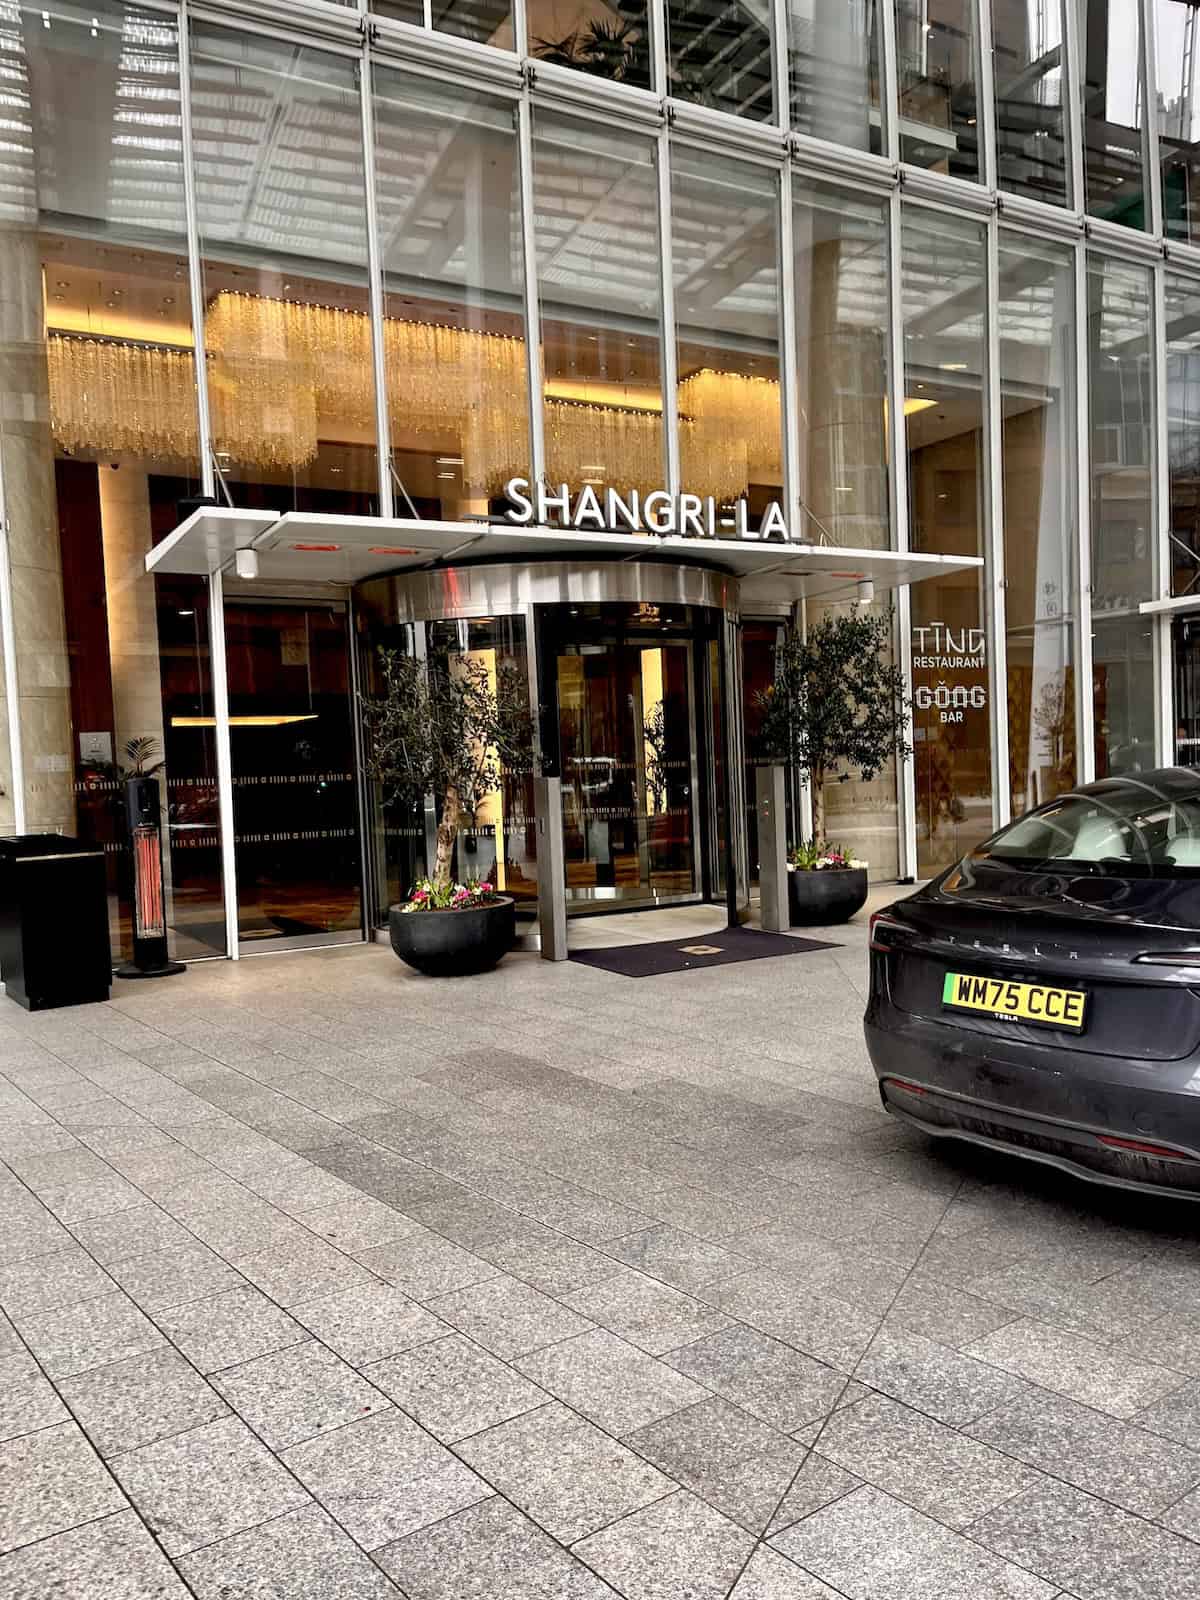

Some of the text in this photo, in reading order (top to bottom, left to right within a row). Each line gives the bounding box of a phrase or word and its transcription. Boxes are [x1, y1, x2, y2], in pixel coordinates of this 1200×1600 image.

[505, 477, 789, 540] SHANGRI-LA
[913, 656, 985, 669] RESTAURANT
[940, 711, 964, 723] BAR
[958, 976, 1081, 1021] WM75 CCE
